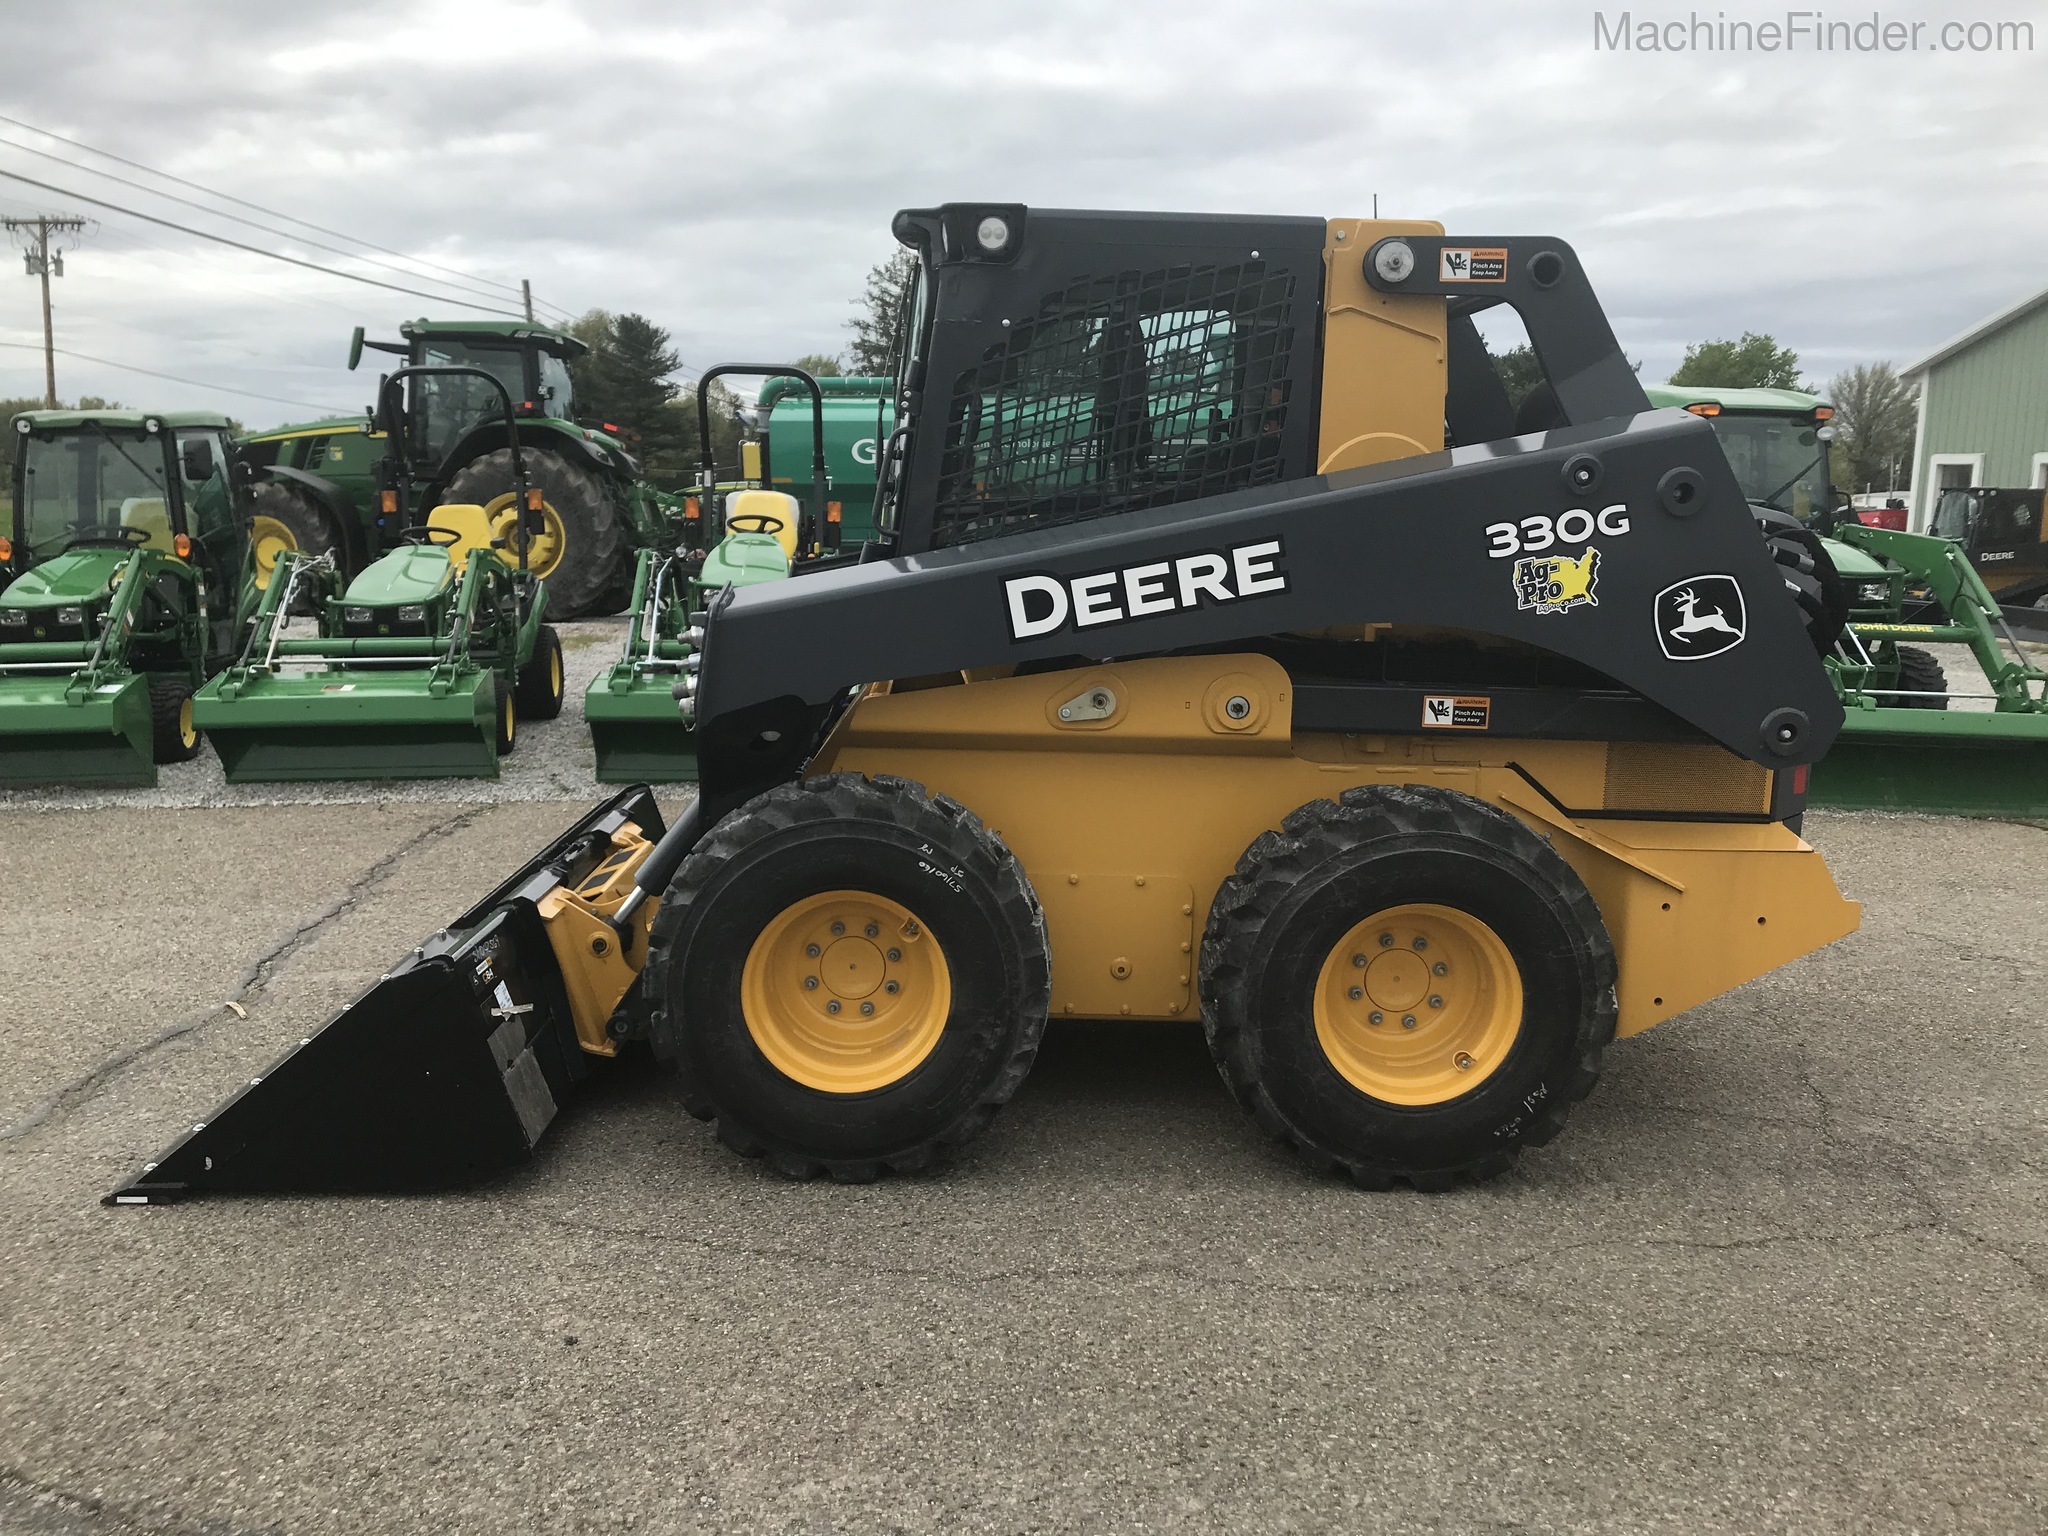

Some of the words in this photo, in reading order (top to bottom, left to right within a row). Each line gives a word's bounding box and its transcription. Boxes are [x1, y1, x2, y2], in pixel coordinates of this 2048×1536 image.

[1485, 504, 1631, 558] 330G
[1981, 551, 2015, 562] DEERE
[1005, 540, 1286, 639] DEERE
[1520, 582, 1562, 605] Pro
[1539, 596, 1586, 612] AgProCo.com
[1854, 623, 1889, 631] JOHN
[1890, 624, 1934, 633] DEERE
